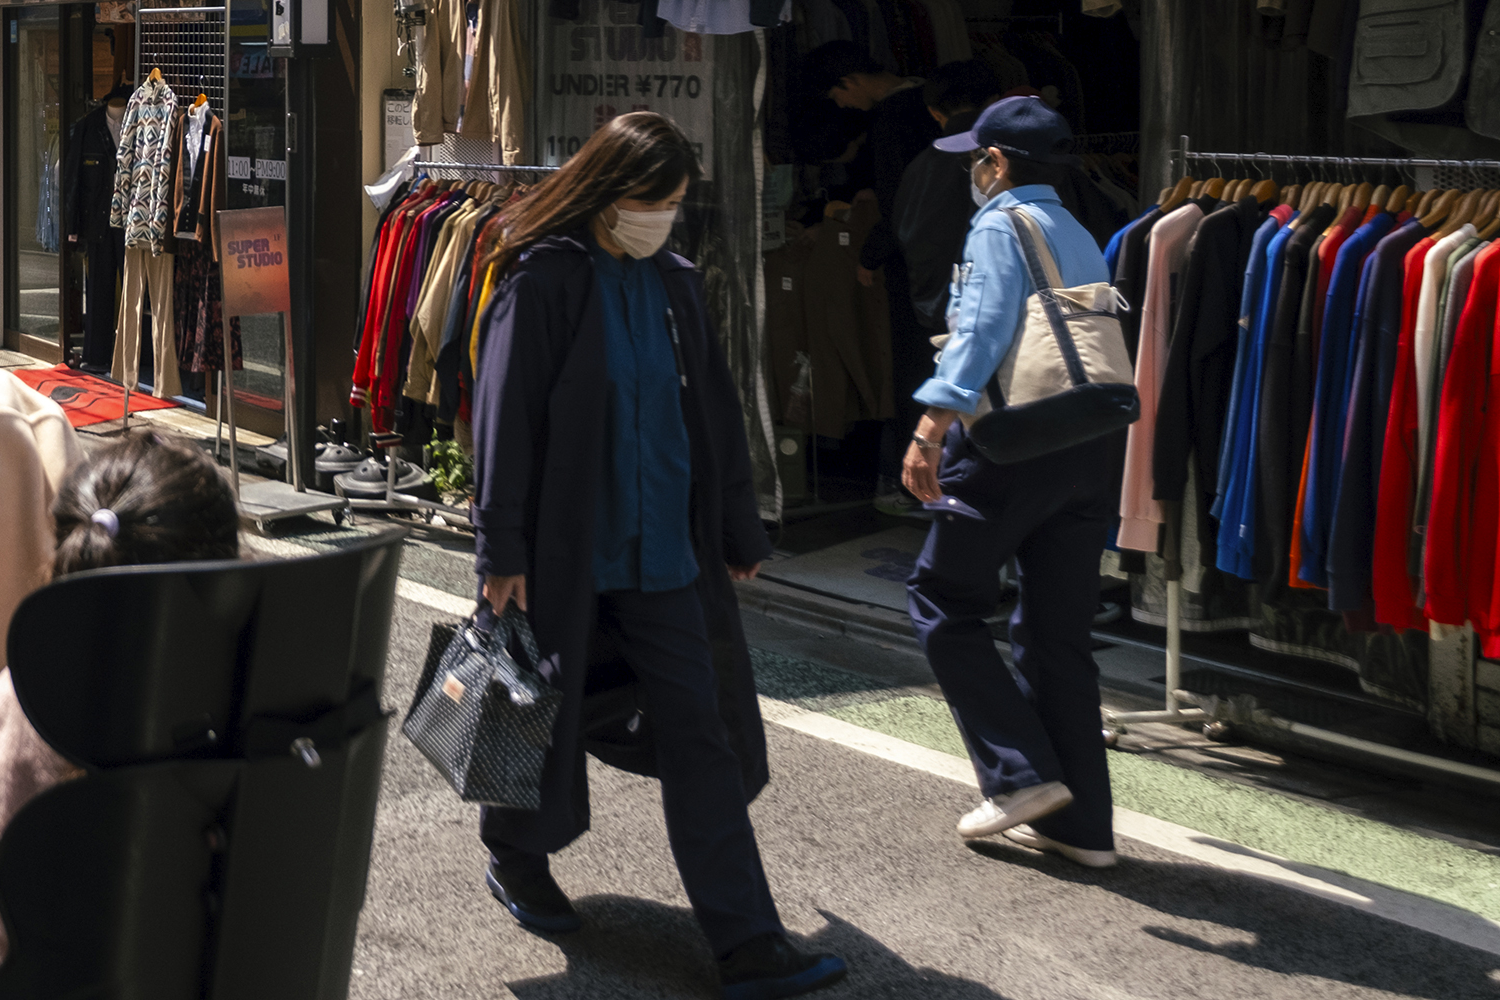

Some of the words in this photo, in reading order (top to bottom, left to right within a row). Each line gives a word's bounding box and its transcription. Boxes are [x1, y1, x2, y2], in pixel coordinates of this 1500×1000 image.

[552, 74, 630, 97] UNDER
[635, 74, 701, 99] ¥770
[227, 238, 270, 256] SUPER
[237, 251, 283, 269] STUDIO
